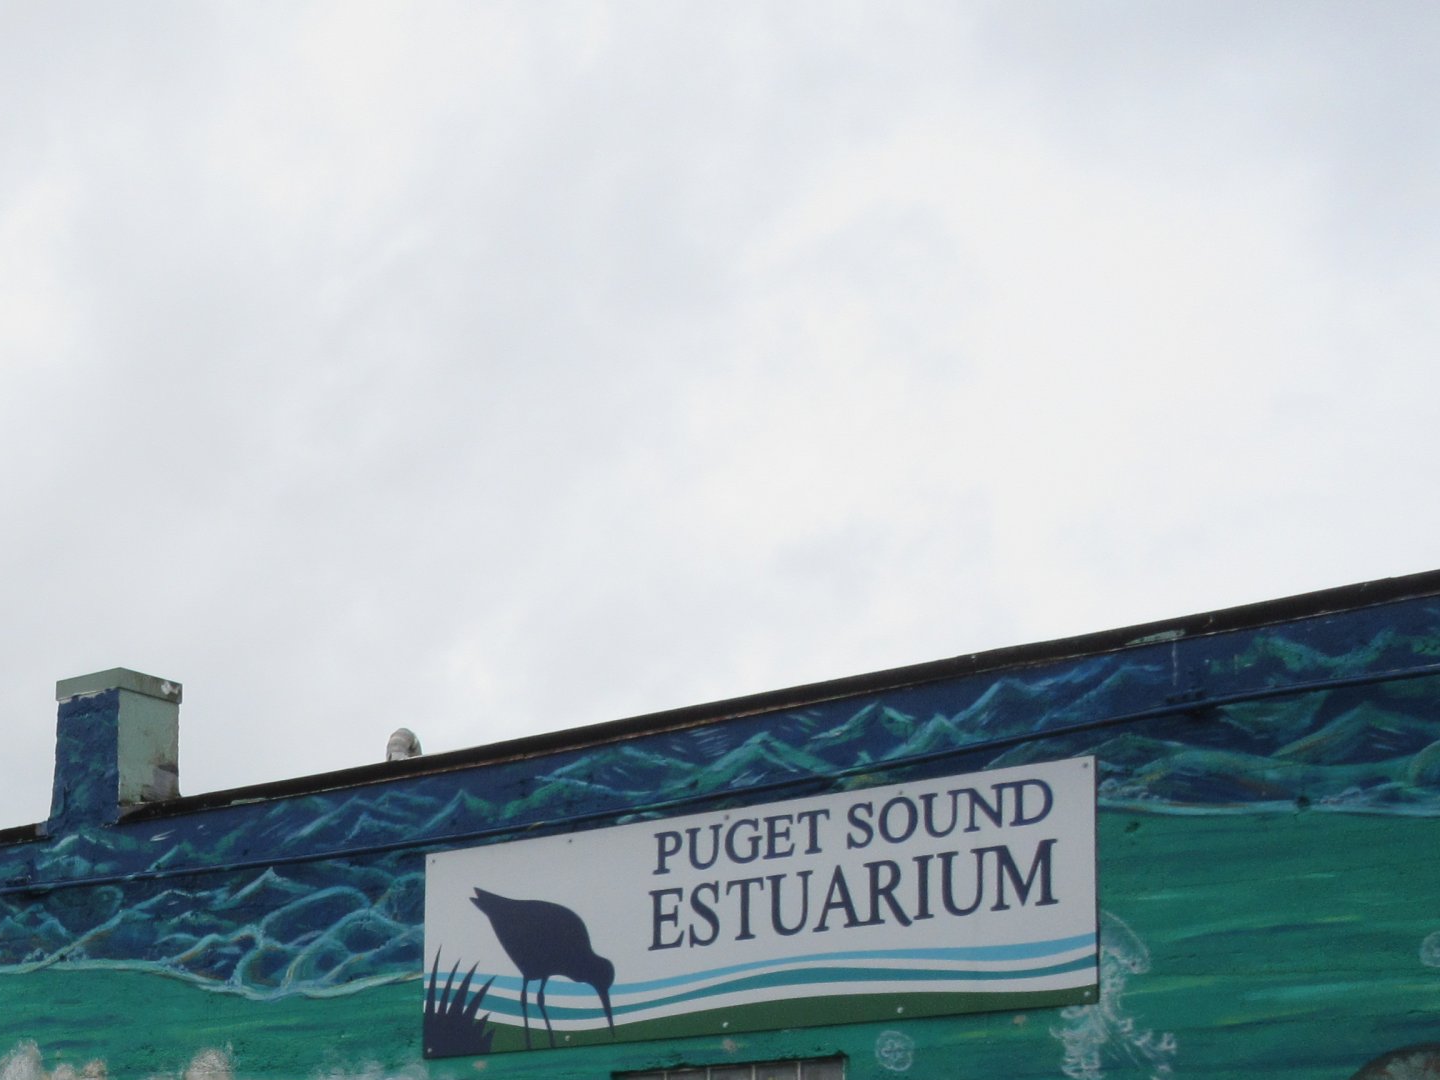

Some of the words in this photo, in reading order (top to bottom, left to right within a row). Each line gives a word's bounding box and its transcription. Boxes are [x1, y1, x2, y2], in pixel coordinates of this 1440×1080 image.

[652, 808, 830, 876] PUGET
[846, 778, 1054, 850] SOUND
[647, 838, 1059, 952] ESTUARIUM
